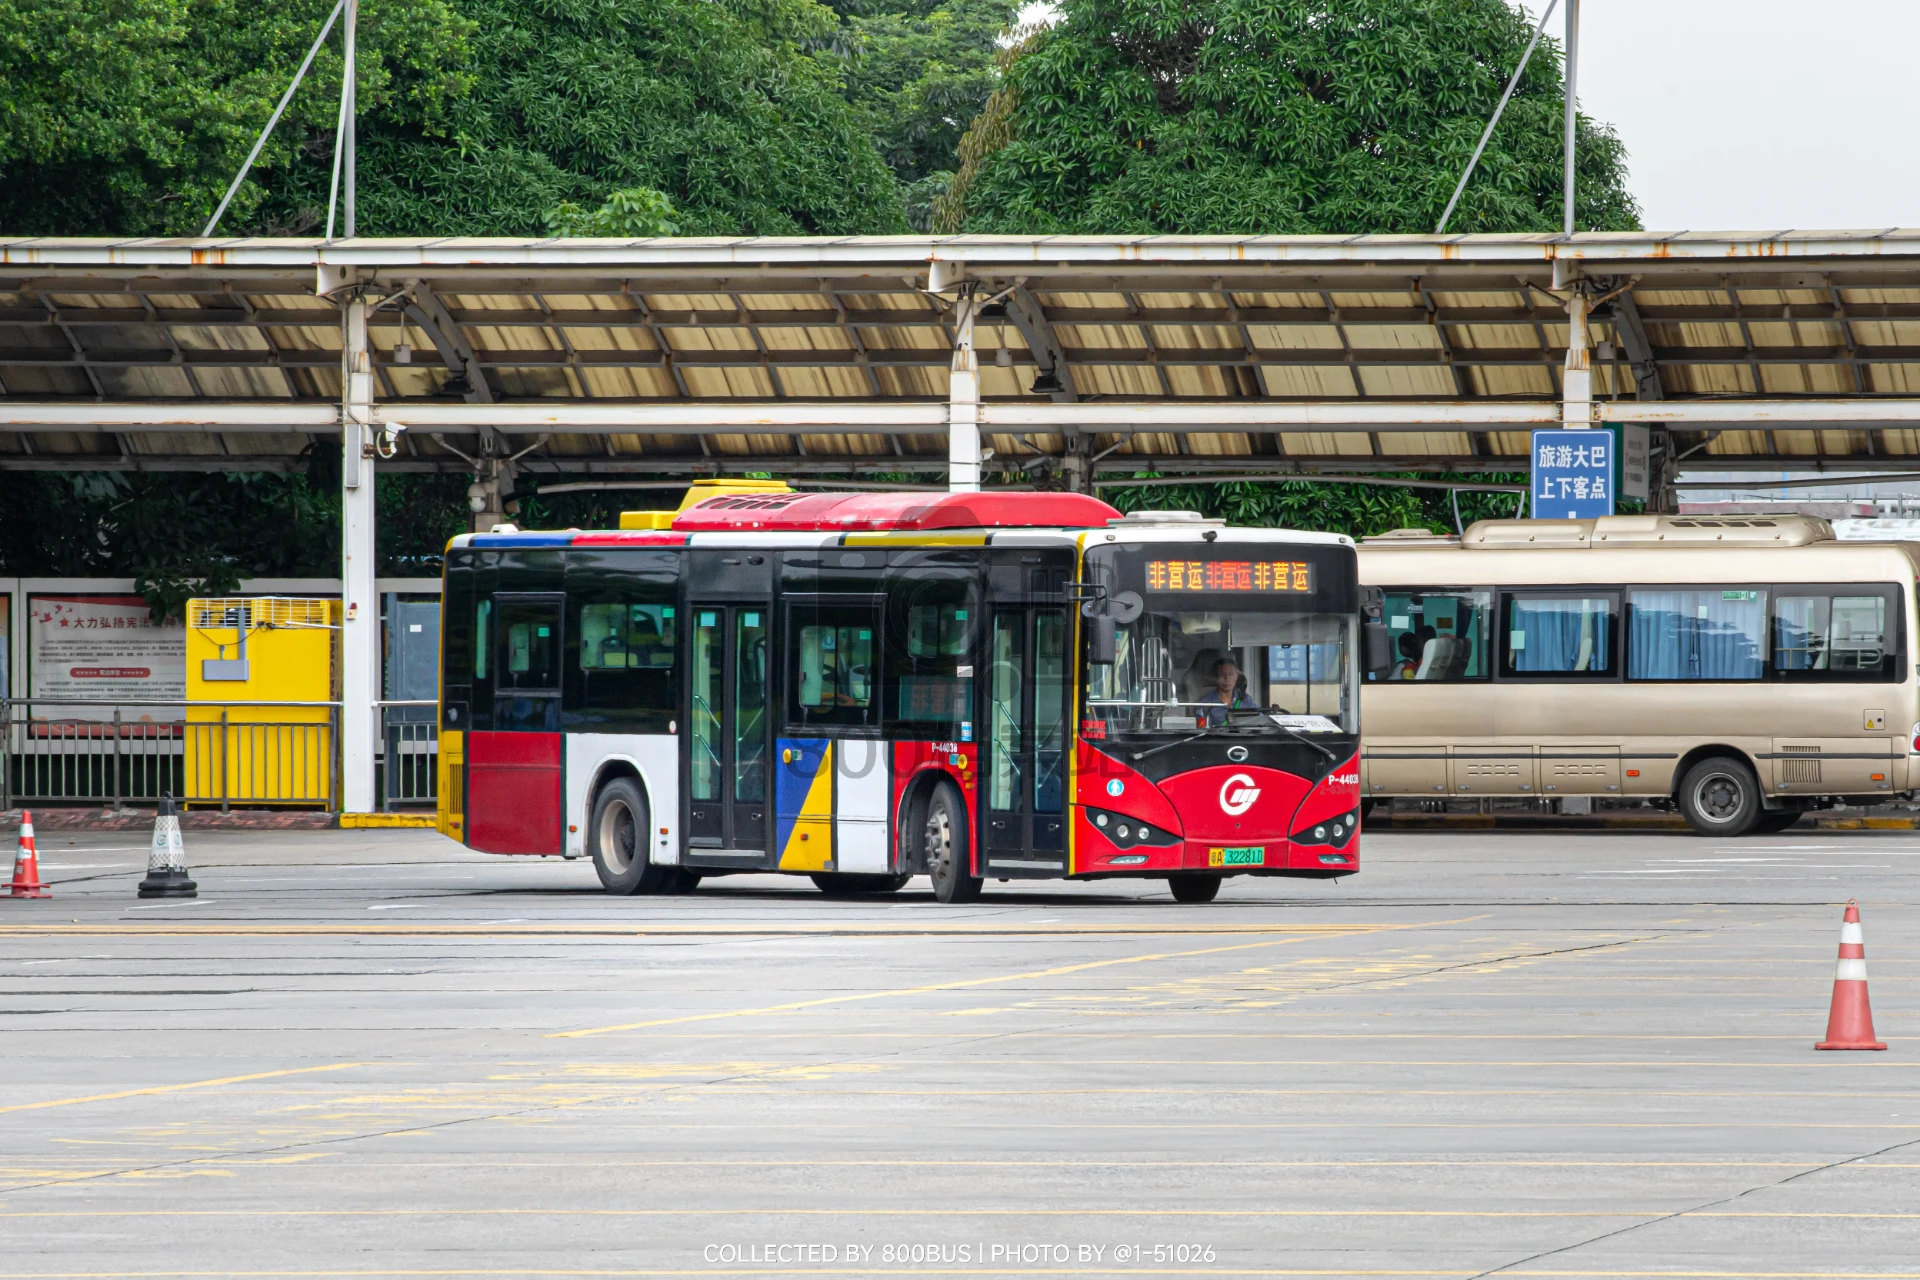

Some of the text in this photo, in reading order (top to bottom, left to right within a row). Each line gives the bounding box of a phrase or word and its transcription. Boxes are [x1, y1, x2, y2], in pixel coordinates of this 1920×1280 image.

[1538, 445, 1606, 468] 旅游大巴
[1538, 476, 1606, 499] 上下客点
[931, 742, 958, 753] P-44038
